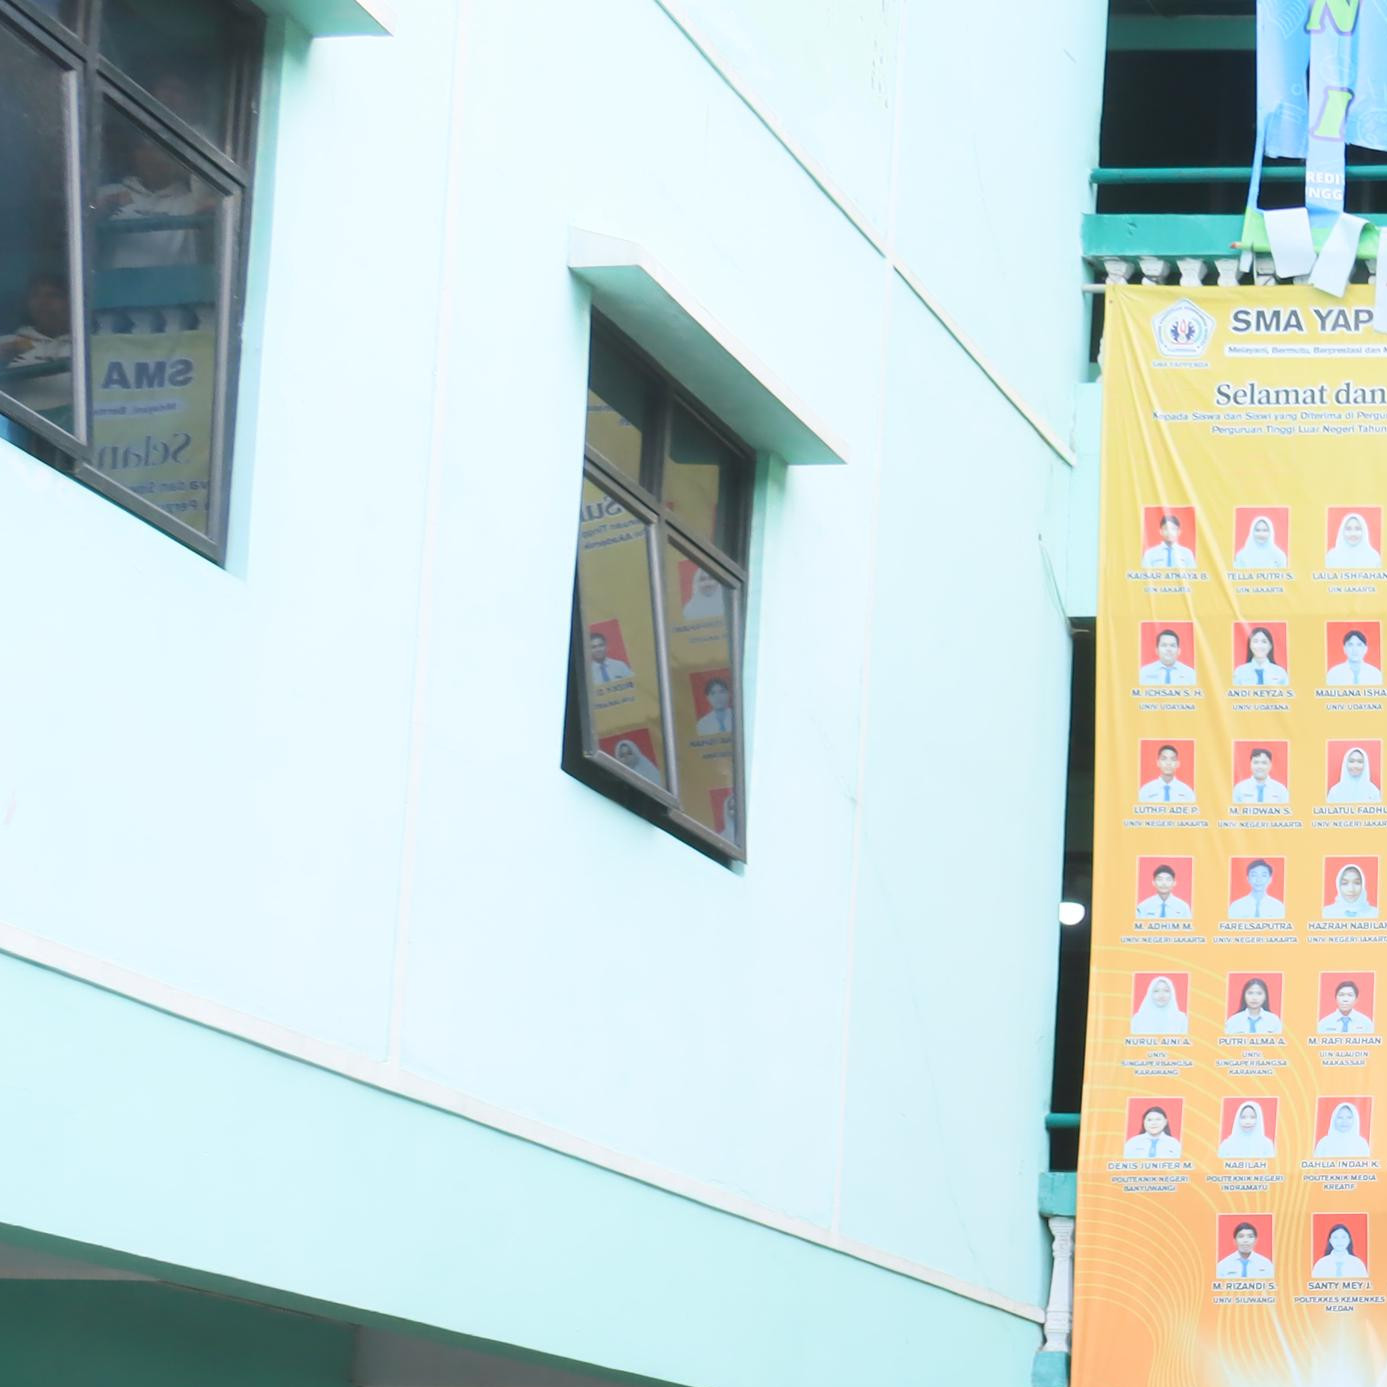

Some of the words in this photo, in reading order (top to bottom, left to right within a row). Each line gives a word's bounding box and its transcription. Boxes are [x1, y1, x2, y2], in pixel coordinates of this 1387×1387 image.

[1232, 309, 1302, 332] SMA
[1216, 382, 1330, 406] Selamat
[1334, 382, 1387, 406] dan
